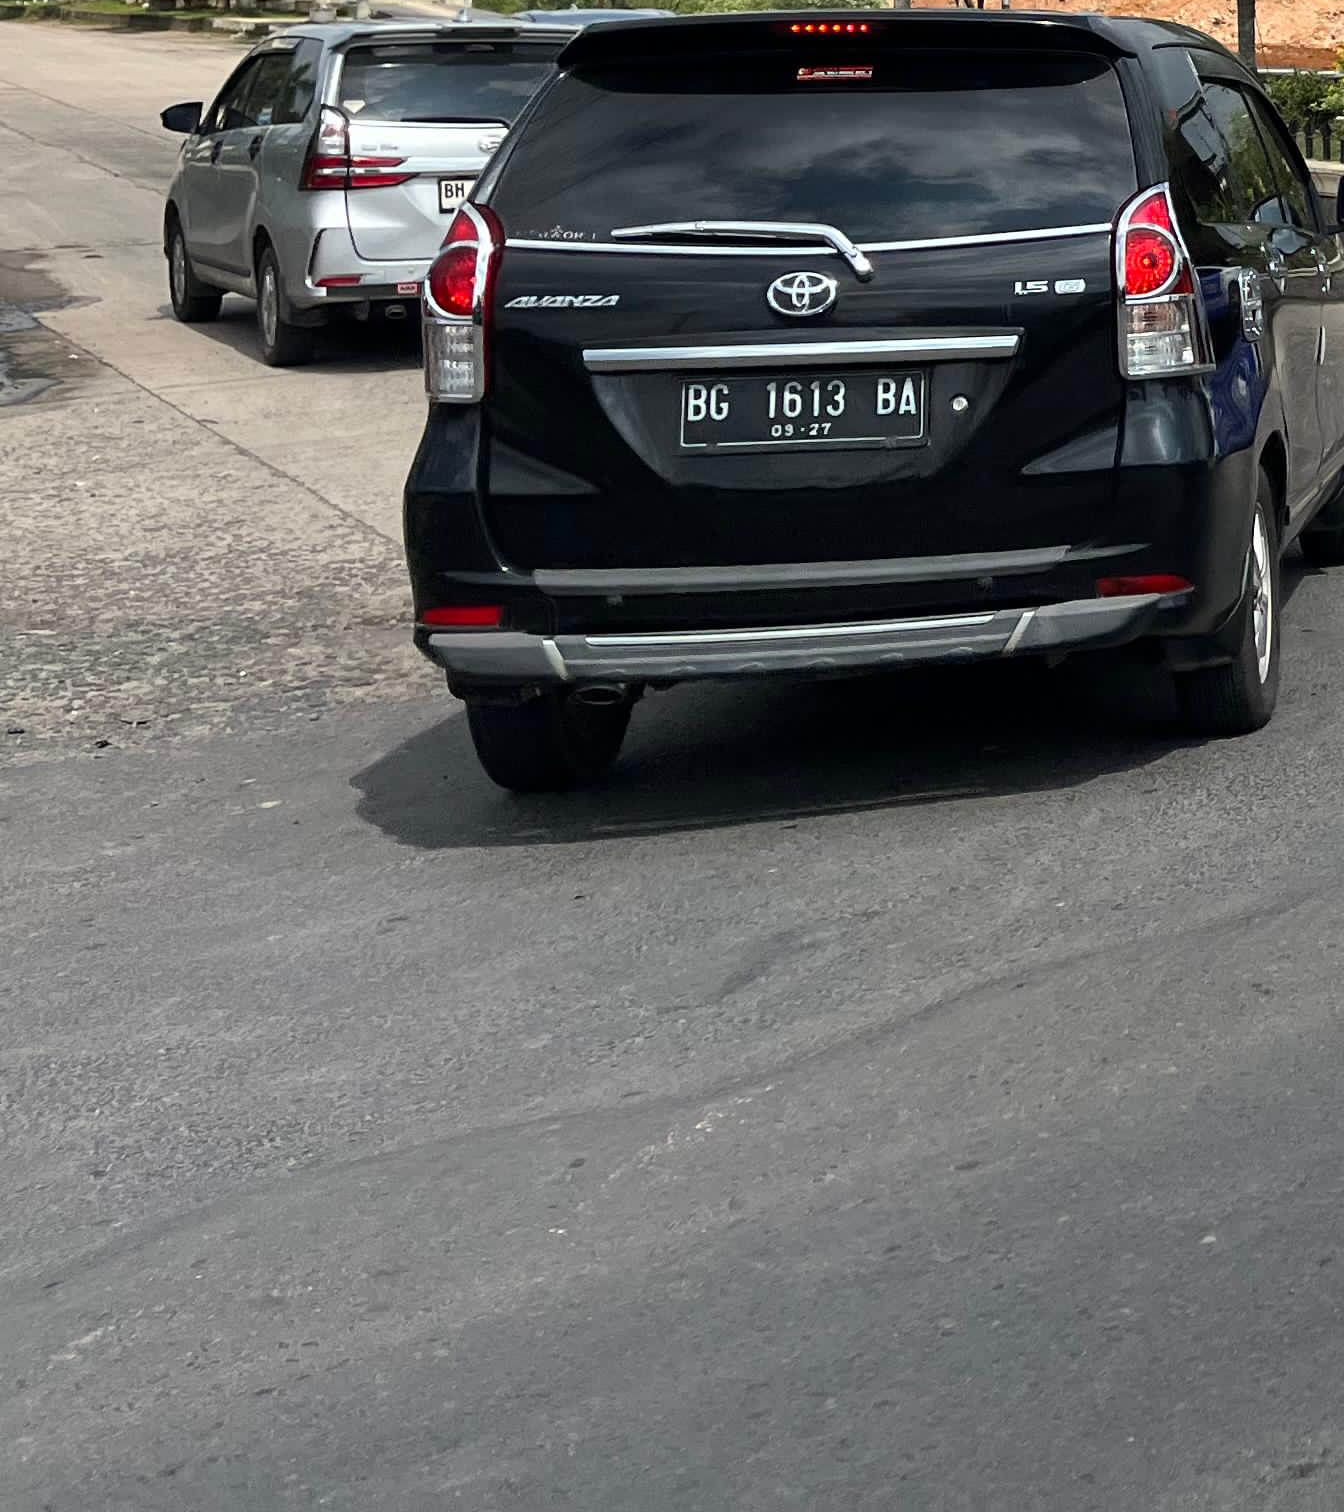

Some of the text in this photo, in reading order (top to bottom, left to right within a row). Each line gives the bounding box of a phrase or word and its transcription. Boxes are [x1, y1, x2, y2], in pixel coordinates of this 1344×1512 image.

[444, 183, 465, 198] BH
[504, 295, 620, 308] AVANZA
[687, 377, 917, 421] BG 1613 BA
